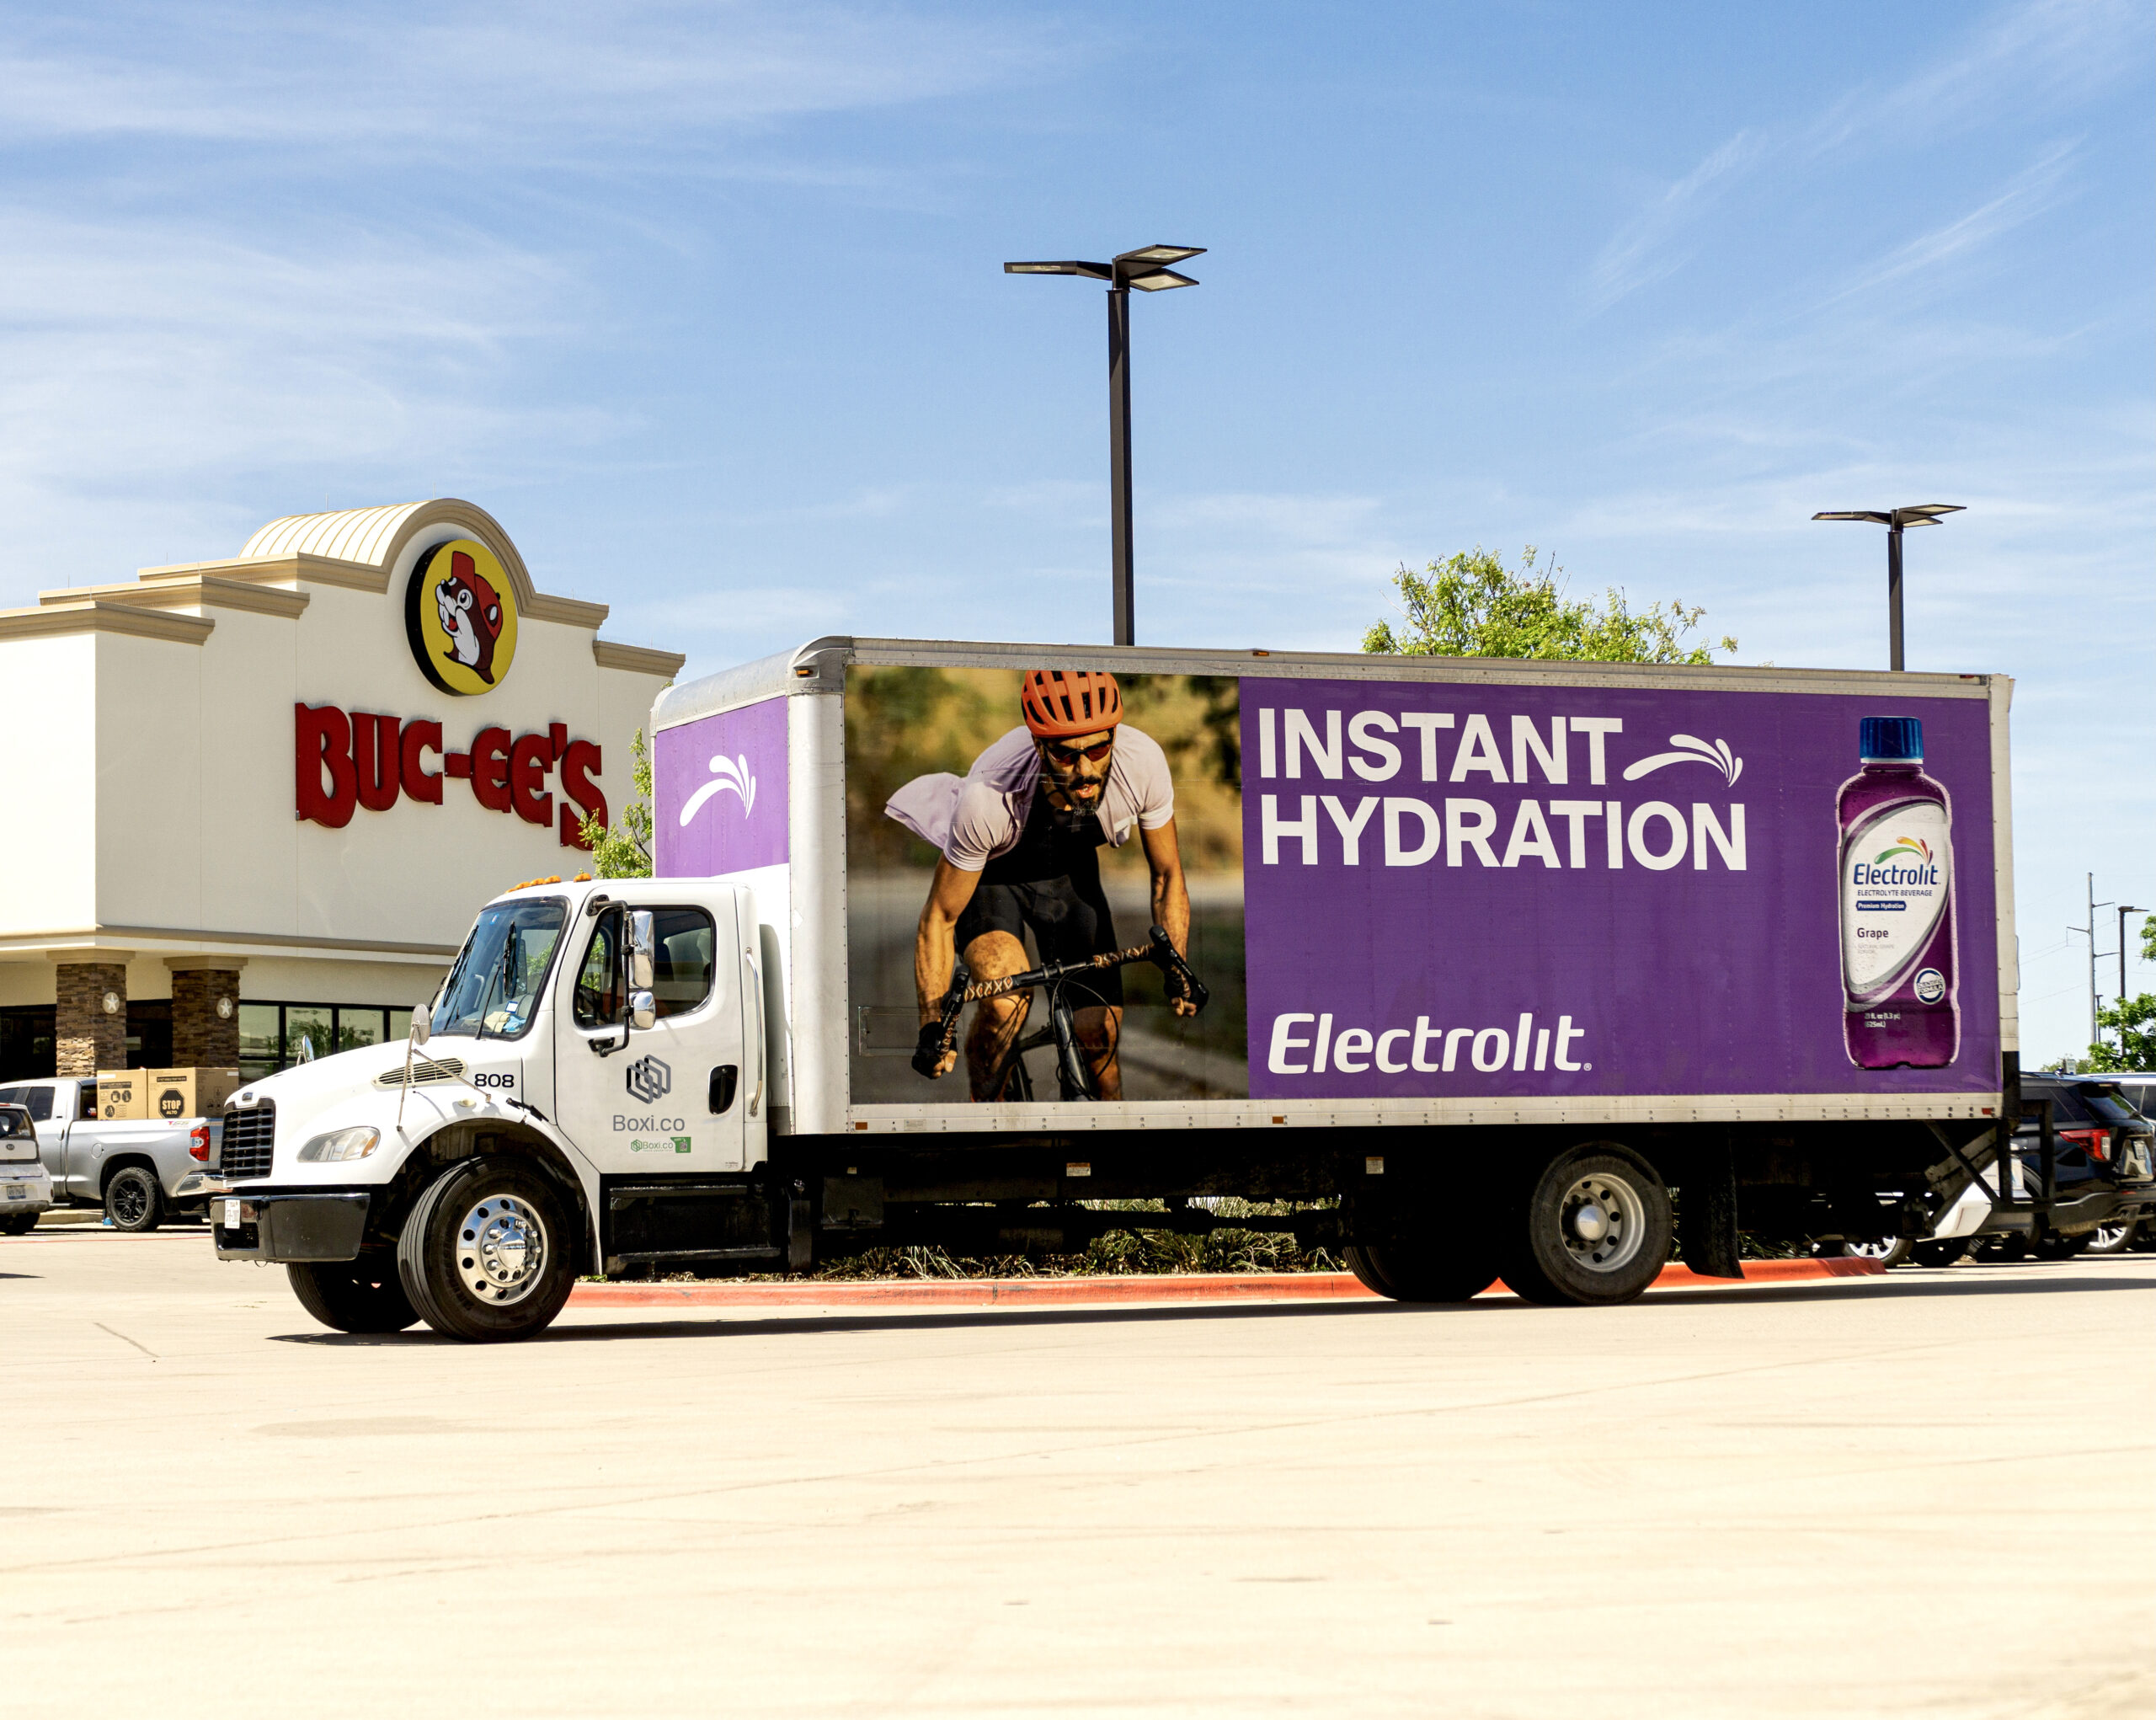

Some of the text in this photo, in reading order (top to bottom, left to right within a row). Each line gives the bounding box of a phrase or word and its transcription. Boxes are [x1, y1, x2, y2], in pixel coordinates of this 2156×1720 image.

[1259, 708, 1623, 785] INSTANT
[1261, 794, 1748, 871] HYDRATION
[1853, 863, 1939, 885] Electrolit
[1857, 927, 1889, 940] Grape
[474, 1073, 515, 1087] 808
[162, 1099, 182, 1110] STOP
[612, 1114, 686, 1132] Boxi.co
[643, 1141, 674, 1150] Boxi.co
